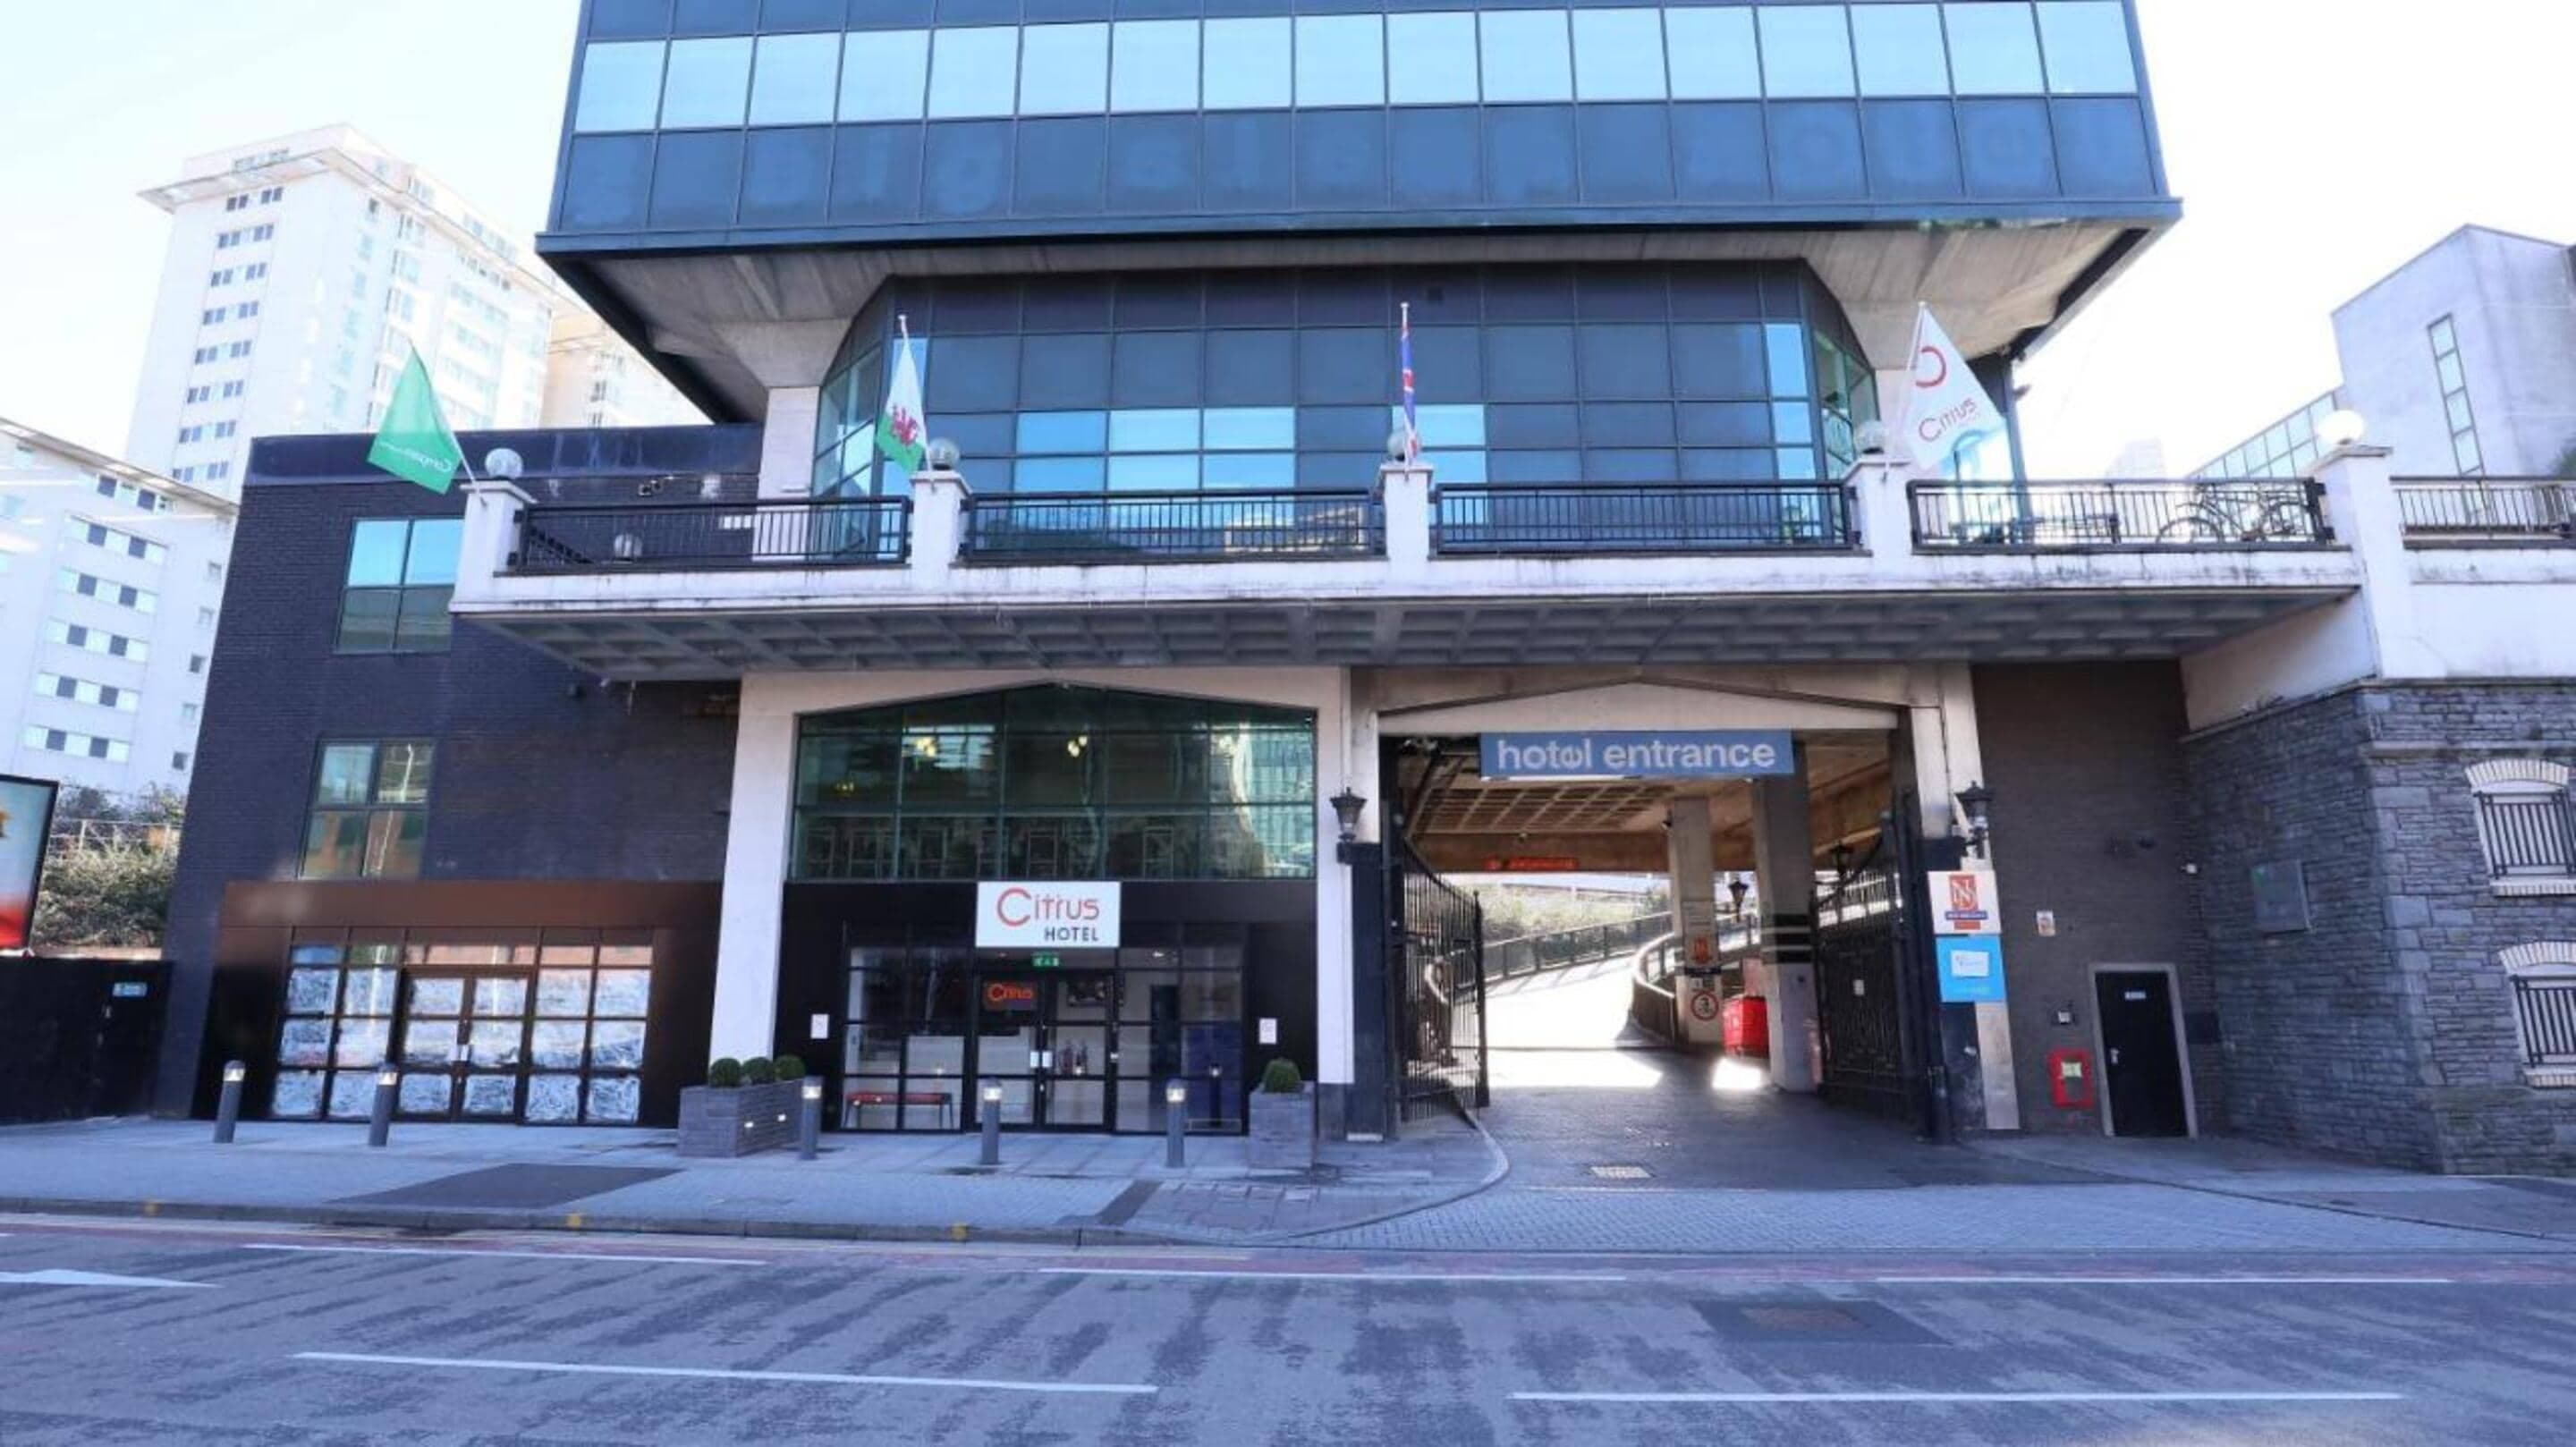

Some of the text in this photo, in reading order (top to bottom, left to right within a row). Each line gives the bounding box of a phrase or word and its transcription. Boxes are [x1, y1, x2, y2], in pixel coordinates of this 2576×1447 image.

[1919, 397, 1978, 442] Citrus
[1497, 738, 1775, 770] hotel entrance
[996, 887, 1100, 927] Citrus
[1044, 927, 1099, 942] HOTEL
